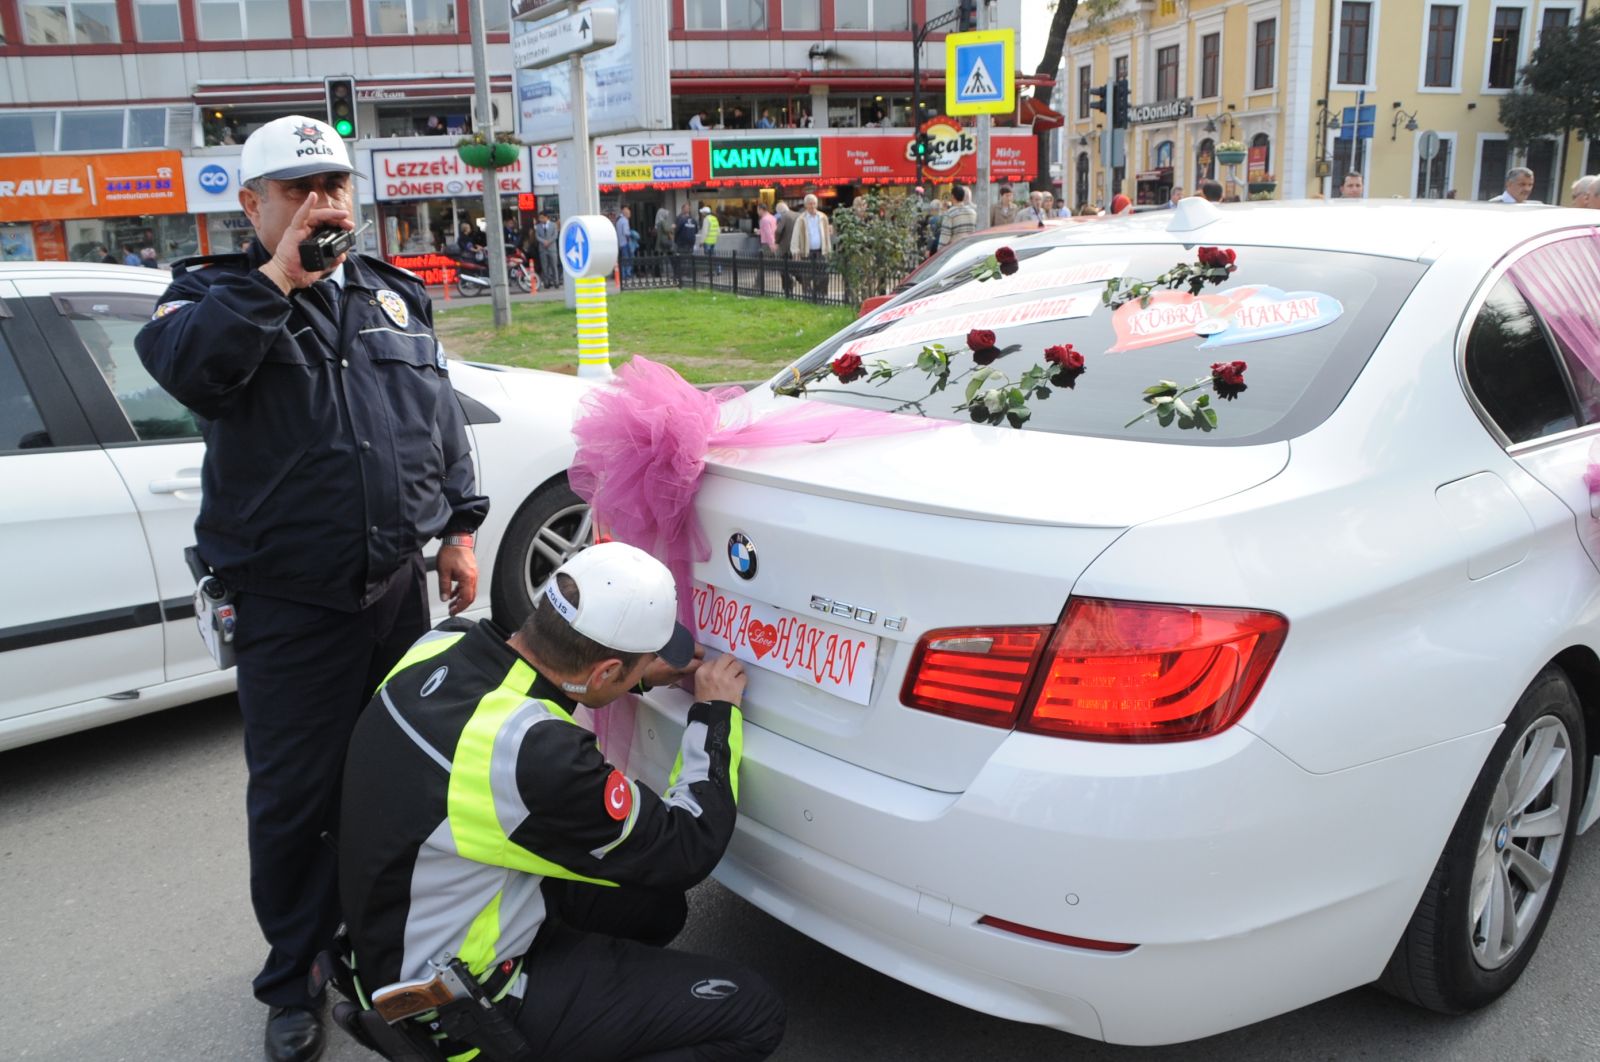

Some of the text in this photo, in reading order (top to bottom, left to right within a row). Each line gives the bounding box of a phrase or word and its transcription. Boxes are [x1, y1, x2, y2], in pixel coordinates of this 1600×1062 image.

[1127, 100, 1186, 121] McDonald's
[296, 145, 334, 157] POLİS
[713, 147, 818, 169] KAHVALTI
[386, 179, 522, 197] DÖNER YEEK
[1237, 298, 1319, 327] HAKAN
[810, 594, 878, 625] 520
[772, 617, 866, 686] HAKAN
